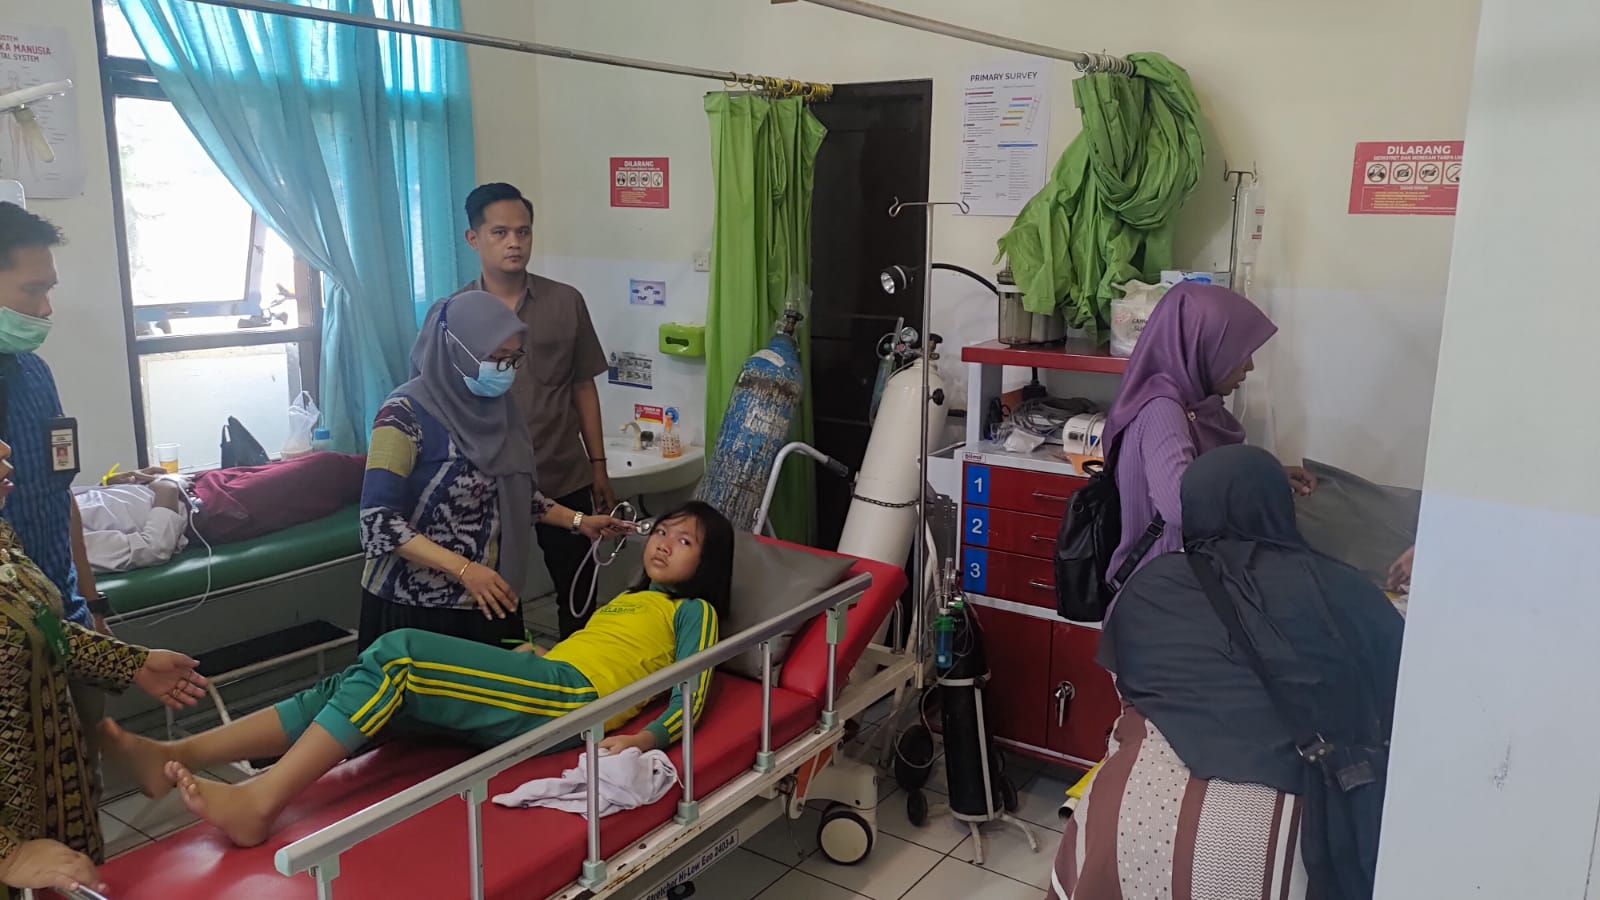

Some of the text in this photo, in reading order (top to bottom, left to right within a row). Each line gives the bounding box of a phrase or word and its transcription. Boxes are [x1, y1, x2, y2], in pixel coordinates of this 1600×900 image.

[13, 43, 51, 55] MANUSIA
[13, 53, 40, 62] SYSTEM
[970, 71, 1038, 81] PRIMARY SURVEY
[1387, 145, 1452, 155] DILARANG
[623, 160, 655, 168] DILARANG
[974, 477, 982, 493] 1
[972, 518, 983, 534] 2
[970, 562, 981, 578] 3
